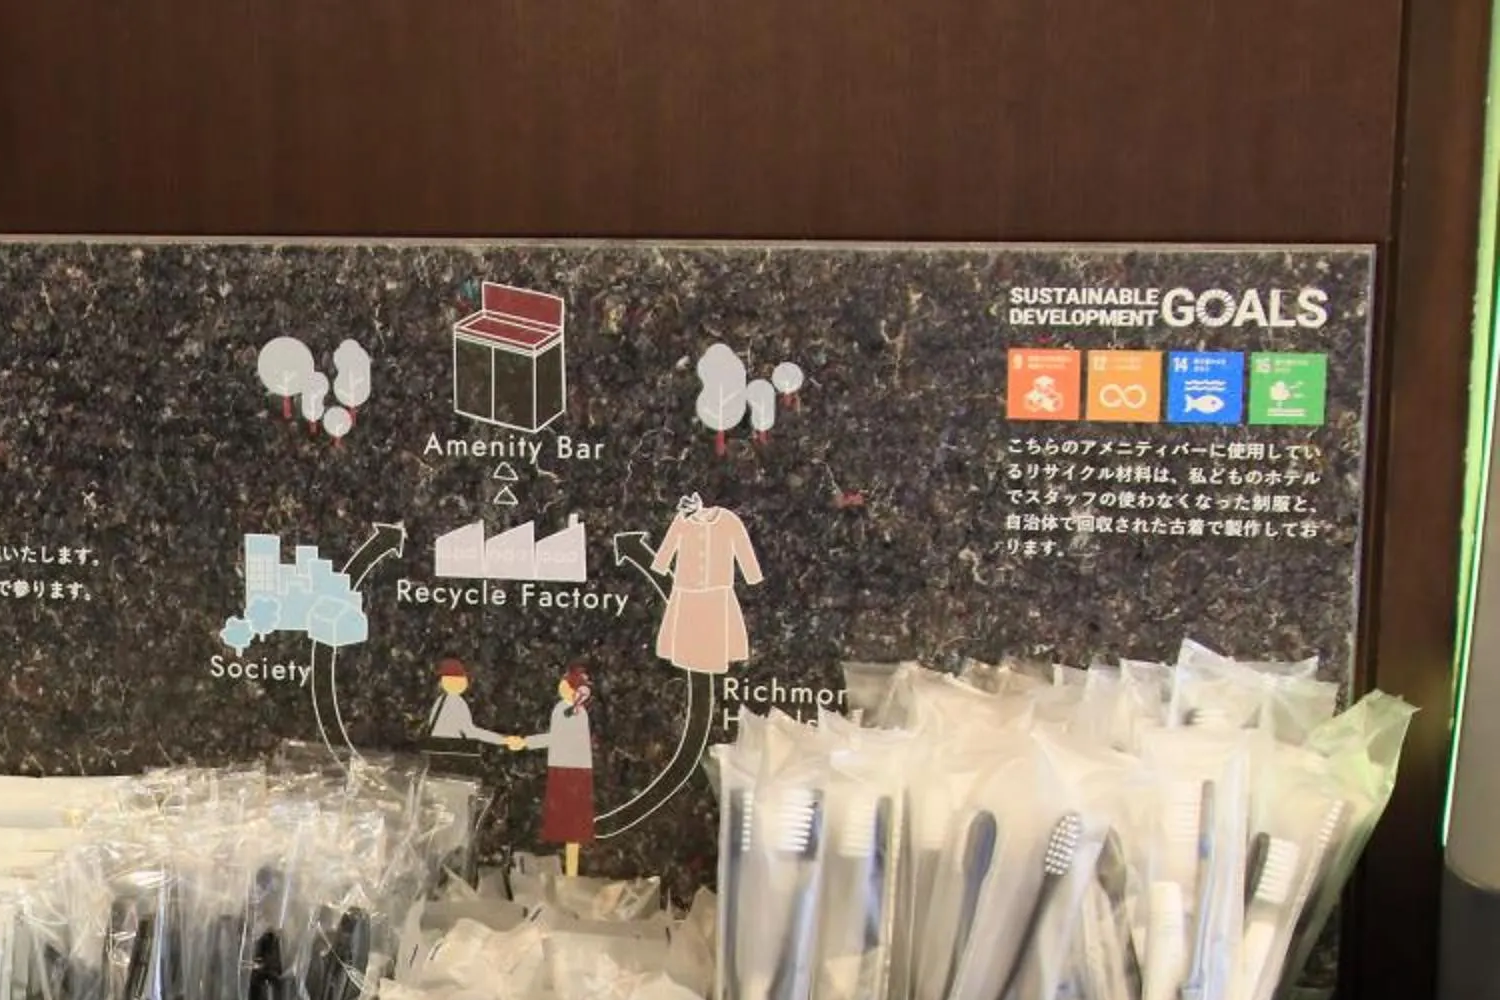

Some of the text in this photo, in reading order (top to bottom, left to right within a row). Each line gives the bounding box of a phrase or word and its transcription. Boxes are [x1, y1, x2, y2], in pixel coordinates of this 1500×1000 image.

[1009, 286, 1160, 306] SUSTAINABLE
[1009, 288, 1328, 328] DEVELOPMENT GOALS
[1173, 357, 1189, 373] 14
[423, 432, 605, 466] Amenity Bar
[1007, 438, 1323, 461] こちらのアメニティバーに使用してい
[1007, 462, 1322, 486] るリサイクル材料は、私どものホテル
[396, 580, 630, 616] Recycle Factory
[209, 655, 313, 687] Society
[722, 677, 849, 705] Richmon
